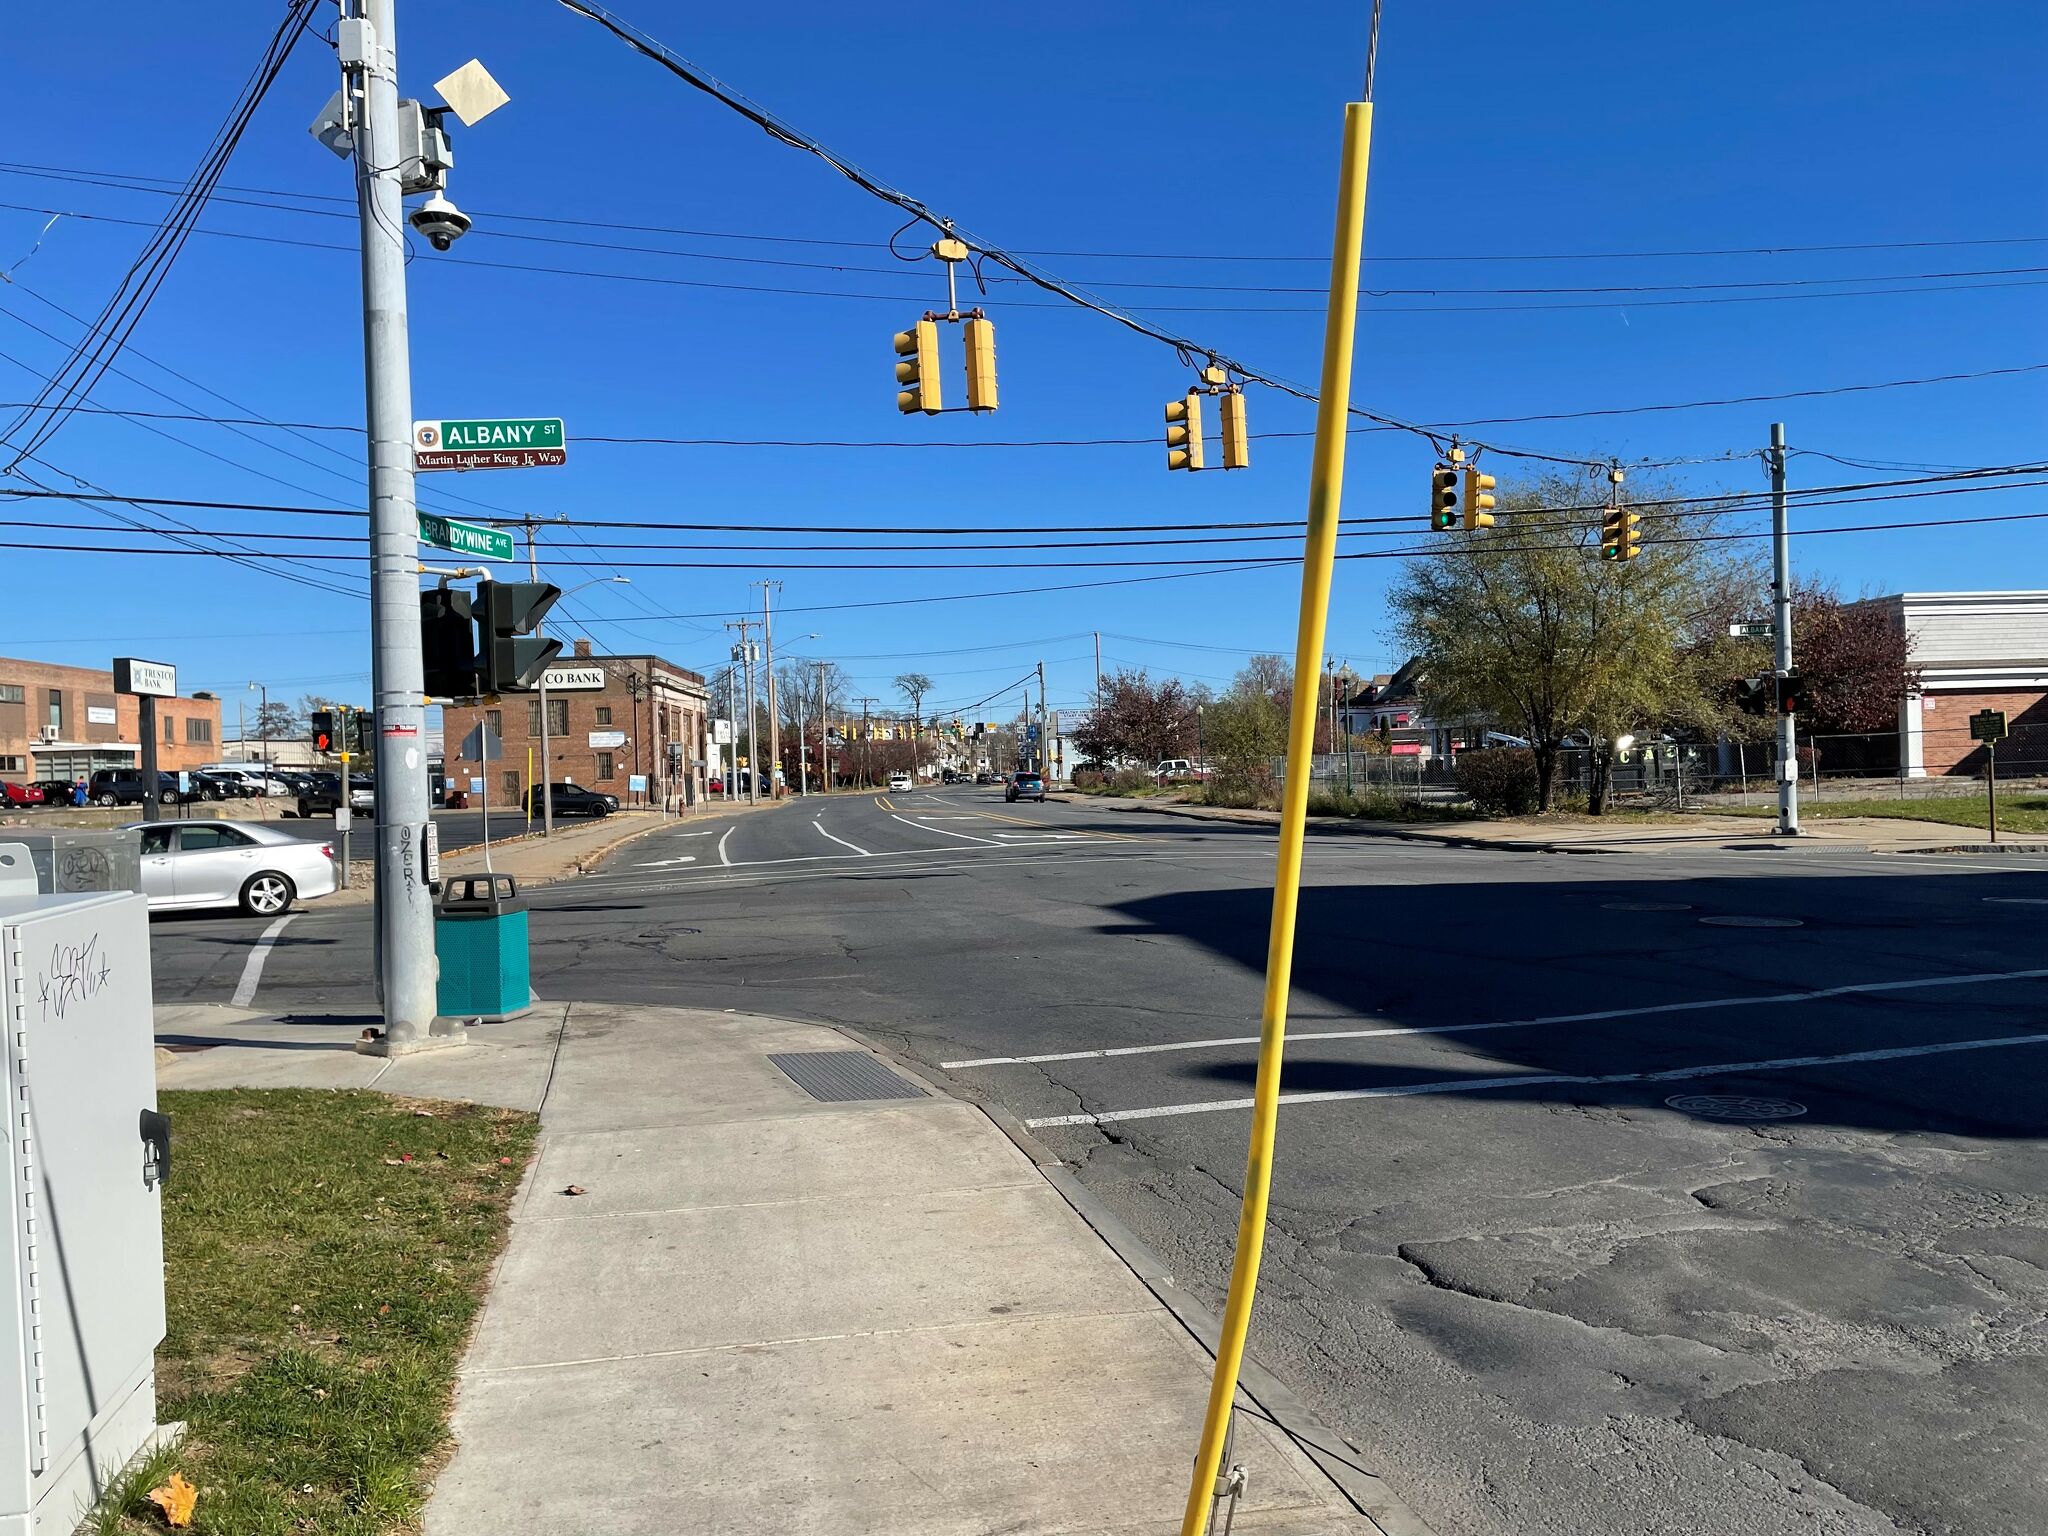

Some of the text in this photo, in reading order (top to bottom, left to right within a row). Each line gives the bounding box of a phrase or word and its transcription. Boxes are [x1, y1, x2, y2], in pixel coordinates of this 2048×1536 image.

[448, 424, 556, 445] ALBANY ST
[419, 455, 453, 465] Martin
[457, 453, 490, 465] Luther
[493, 453, 518, 466] King
[538, 452, 562, 465] Way
[425, 519, 508, 551] BRANDYWINE AVE
[1741, 626, 1769, 634] ALBANY
[144, 668, 174, 681] TRUSTCO
[567, 673, 601, 684] BANK
[144, 678, 162, 689] BANK
